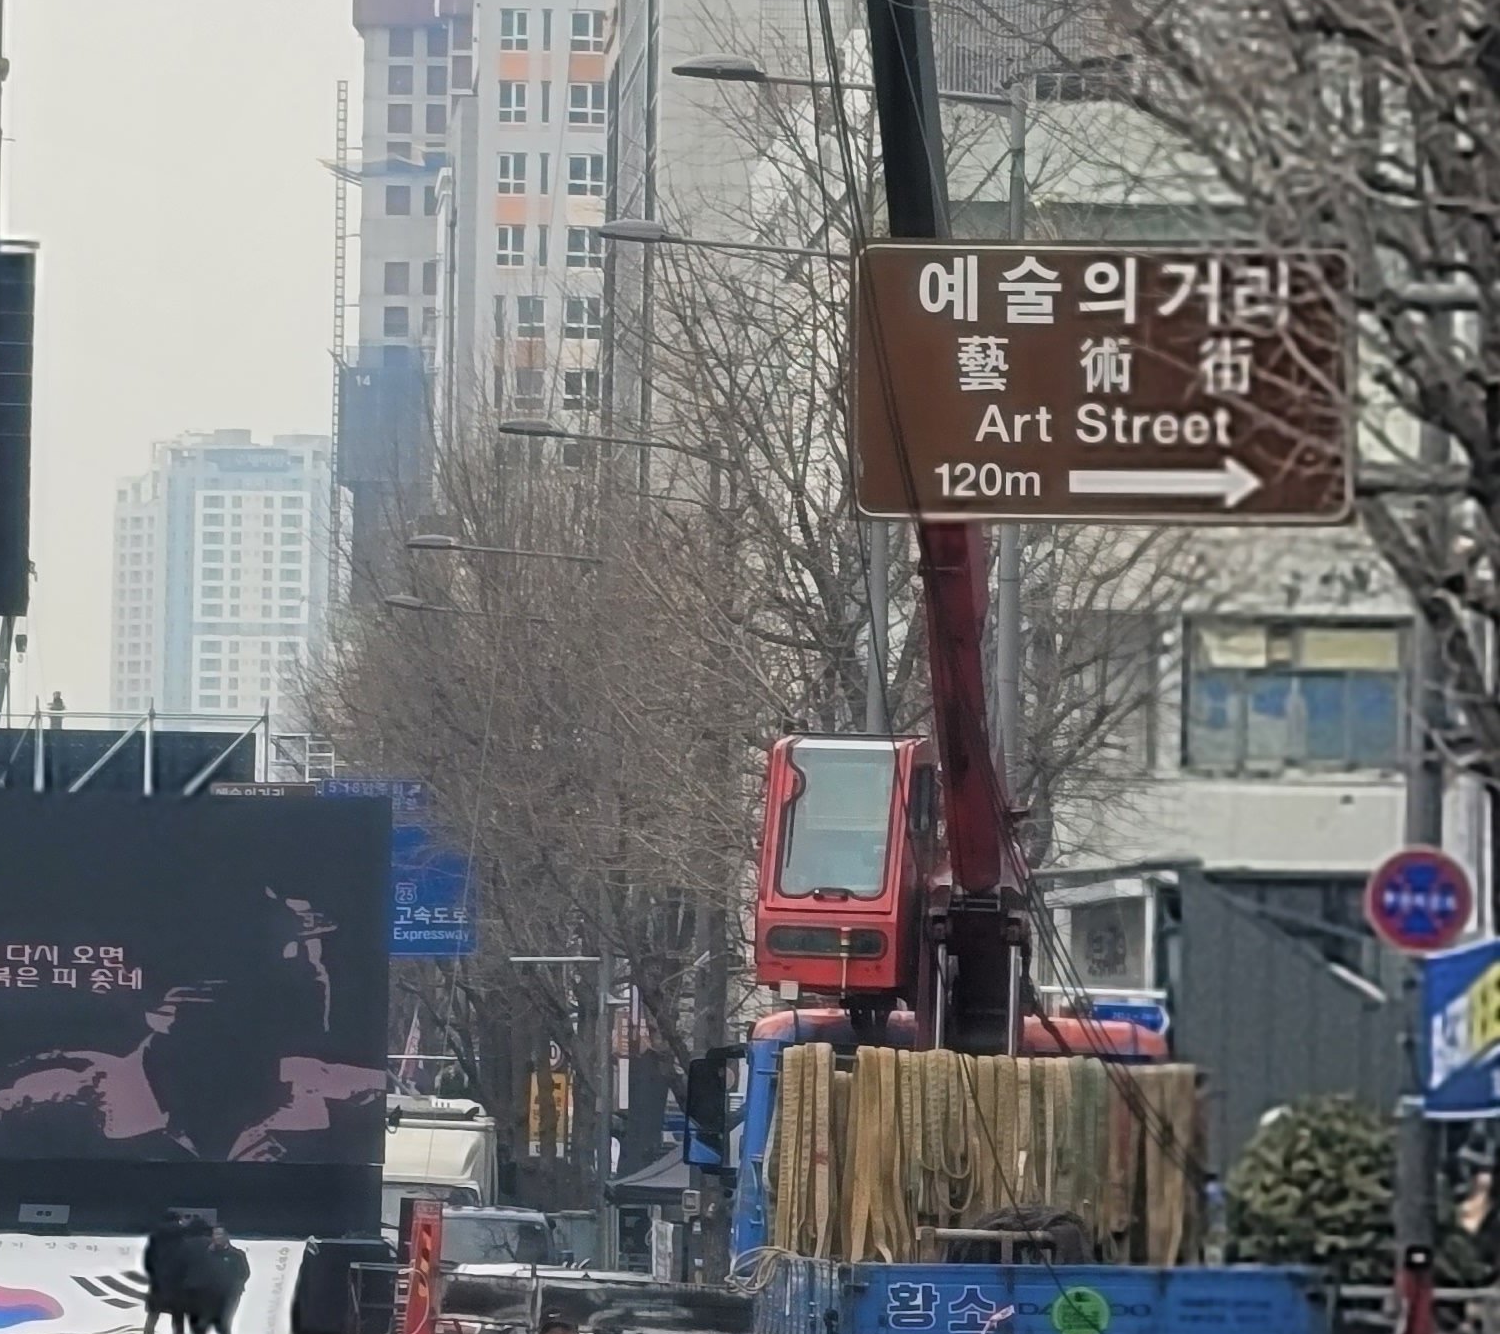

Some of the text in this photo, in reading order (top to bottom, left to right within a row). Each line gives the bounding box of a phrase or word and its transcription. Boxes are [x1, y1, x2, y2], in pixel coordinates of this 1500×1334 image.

[975, 402, 1233, 446] Art Street
[934, 462, 1042, 498] 120m
[393, 906, 469, 925] 고속도로
[393, 927, 469, 942] Expressway
[5, 944, 59, 966] 다시
[70, 945, 124, 968] 오면
[51, 967, 78, 989] 피
[887, 1282, 997, 1334] 황소
[1018, 1302, 1153, 1317] DAOO
